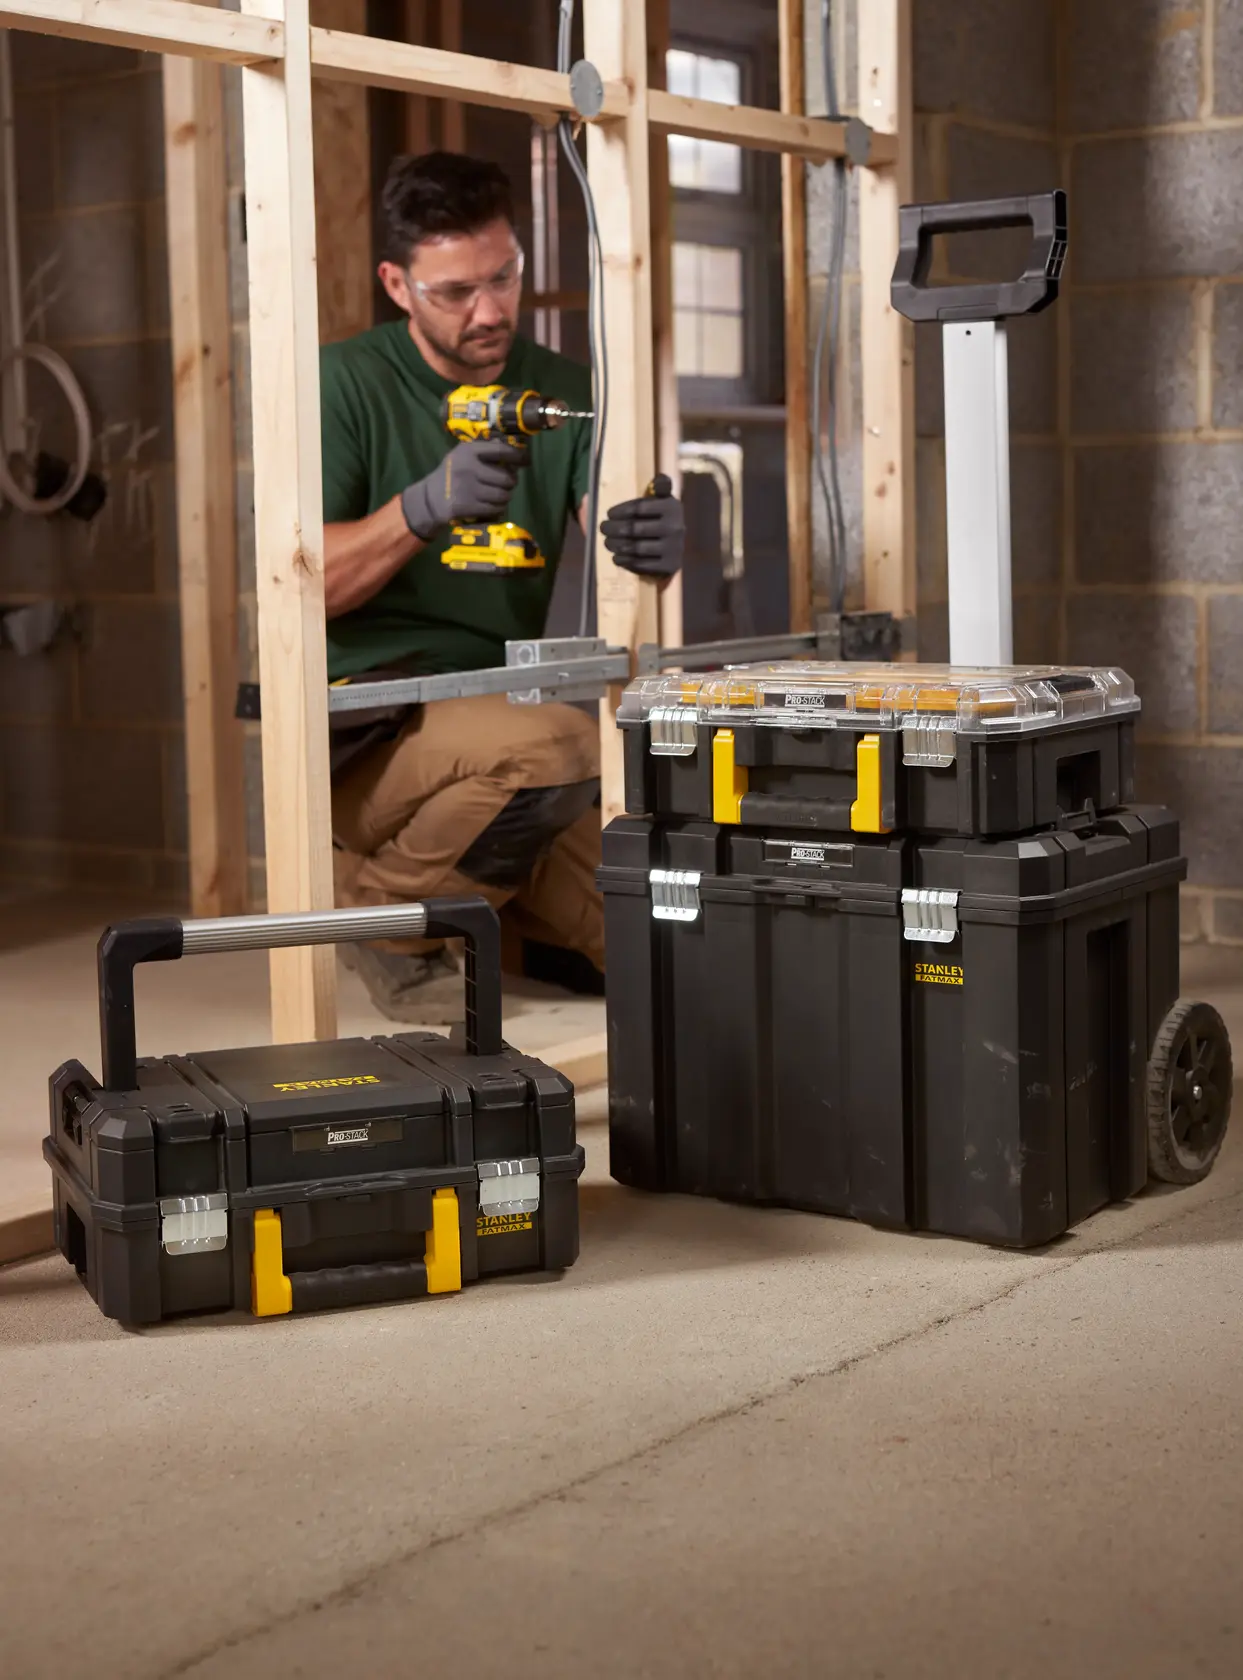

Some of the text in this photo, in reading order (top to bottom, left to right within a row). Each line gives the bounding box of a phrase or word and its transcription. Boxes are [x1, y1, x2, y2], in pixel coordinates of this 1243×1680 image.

[915, 963, 964, 976] STANLEY
[919, 975, 960, 984] FATMAX
[481, 1223, 526, 1235] FATMAX
